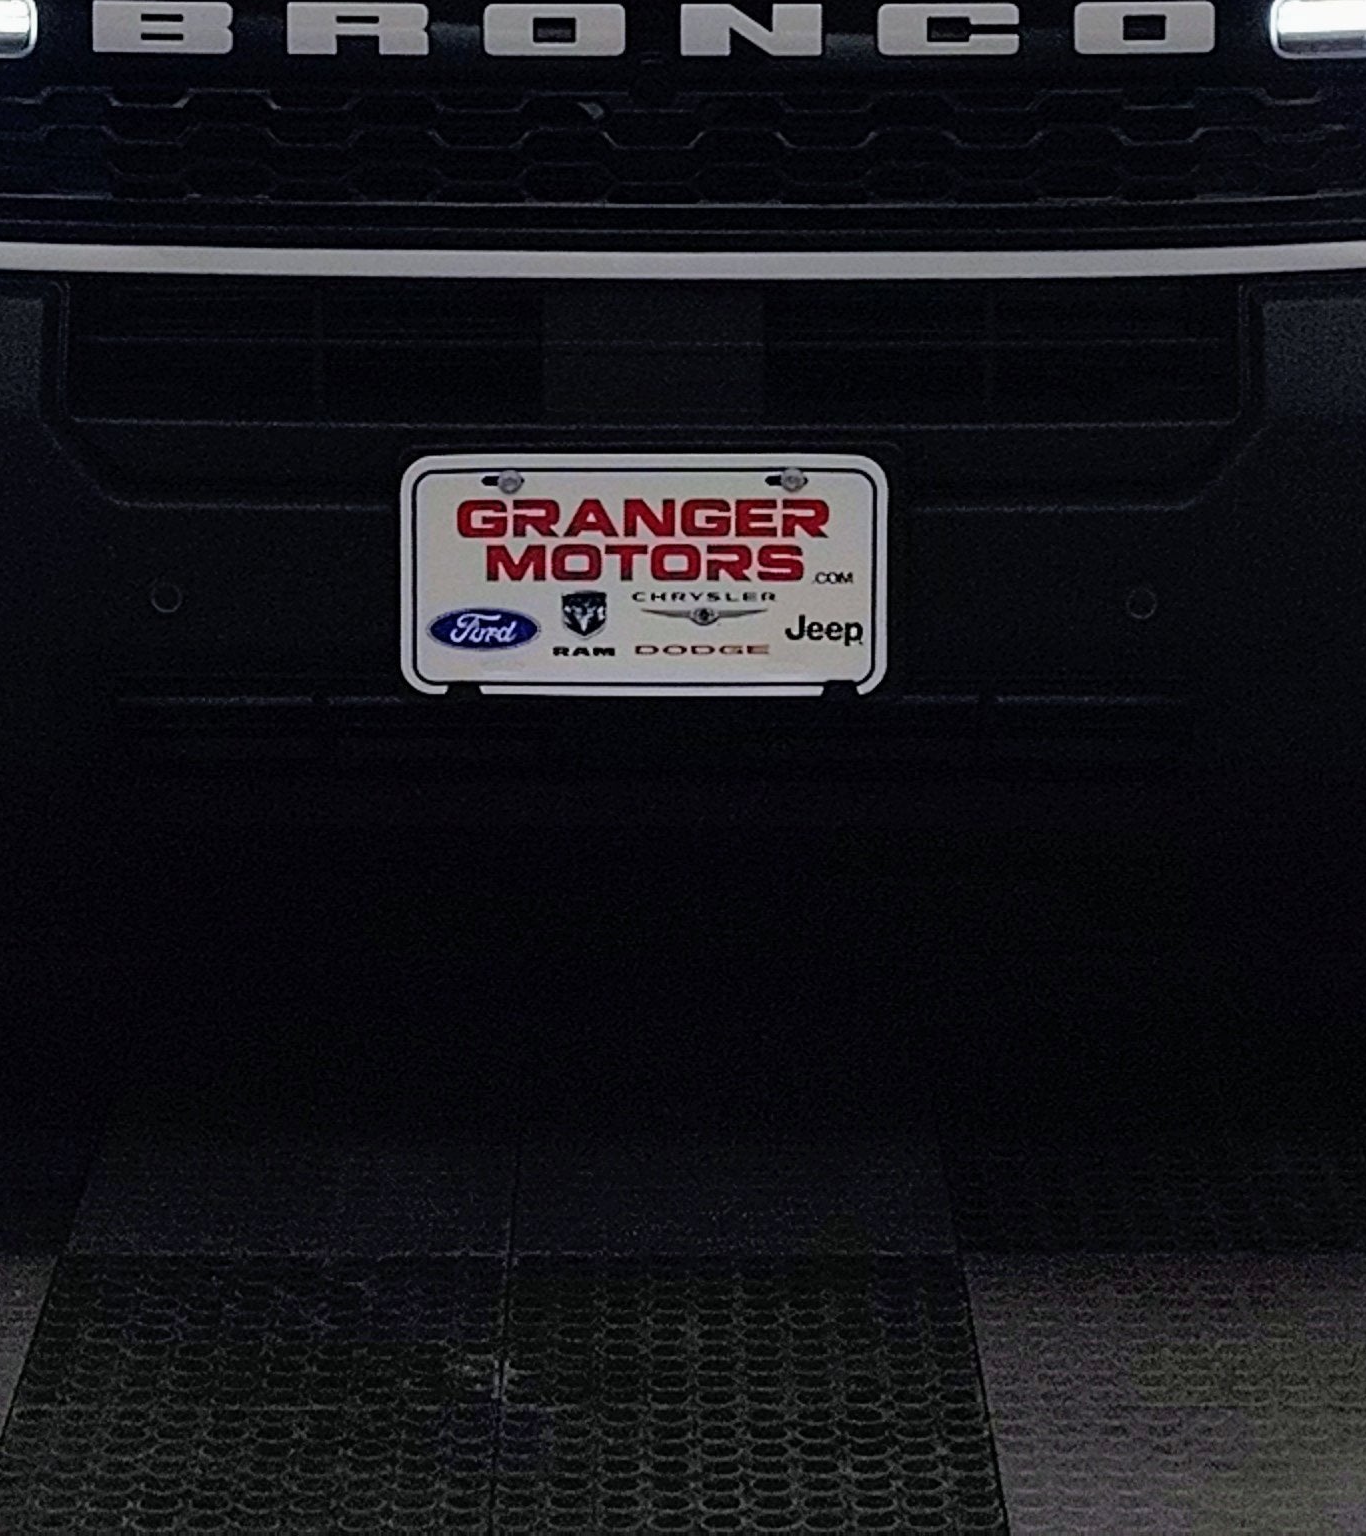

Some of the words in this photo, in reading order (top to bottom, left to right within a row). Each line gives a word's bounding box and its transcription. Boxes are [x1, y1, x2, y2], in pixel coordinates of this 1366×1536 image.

[92, 0, 1217, 57] BRONCO
[456, 498, 830, 539] GRANGER
[485, 543, 805, 583] MOTORS
[811, 571, 854, 585] .COM
[631, 591, 777, 603] CHRYSLER
[449, 612, 519, 644] Ford
[785, 615, 864, 647] Jeep
[552, 646, 616, 657] RAM
[634, 643, 772, 656] DODGE
